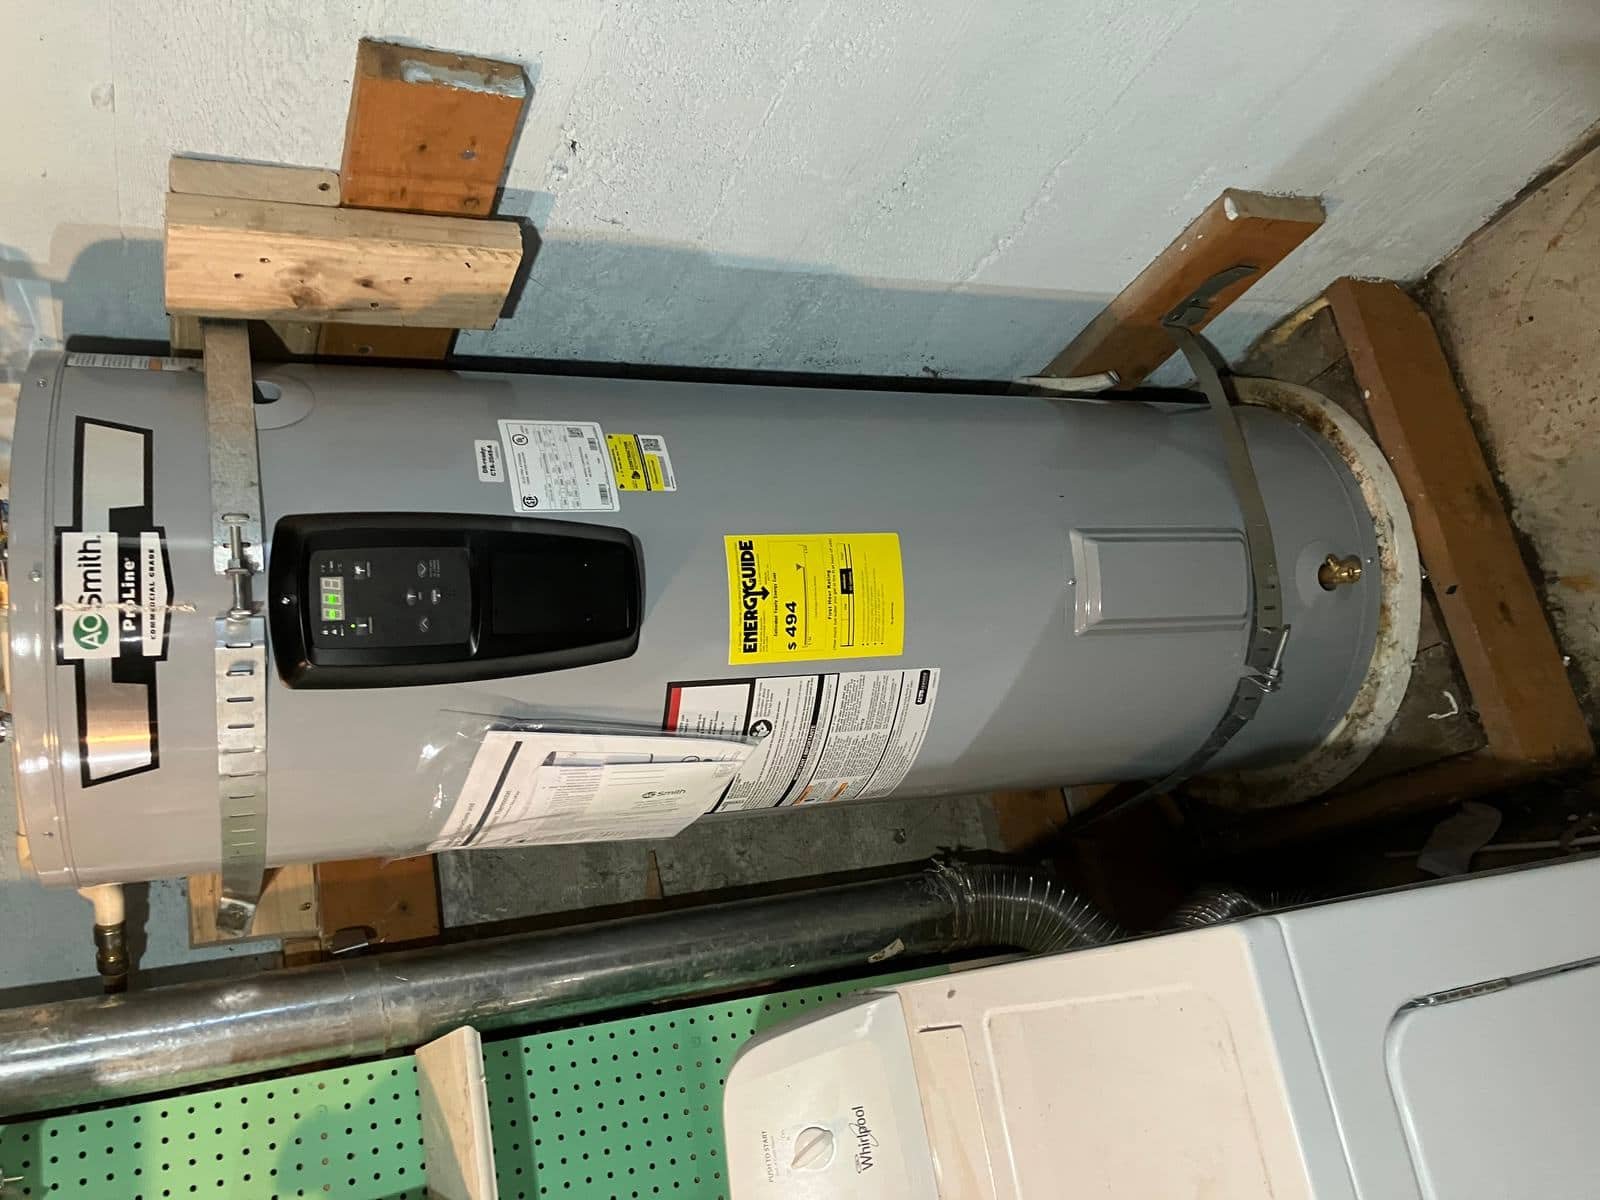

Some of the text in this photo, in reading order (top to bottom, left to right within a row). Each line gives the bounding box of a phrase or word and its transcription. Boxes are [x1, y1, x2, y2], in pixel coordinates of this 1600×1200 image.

[739, 540, 761, 653] ENERGYGUIDE
[785, 602, 797, 650] $ 494
[851, 1106, 873, 1170] Whirlpool
